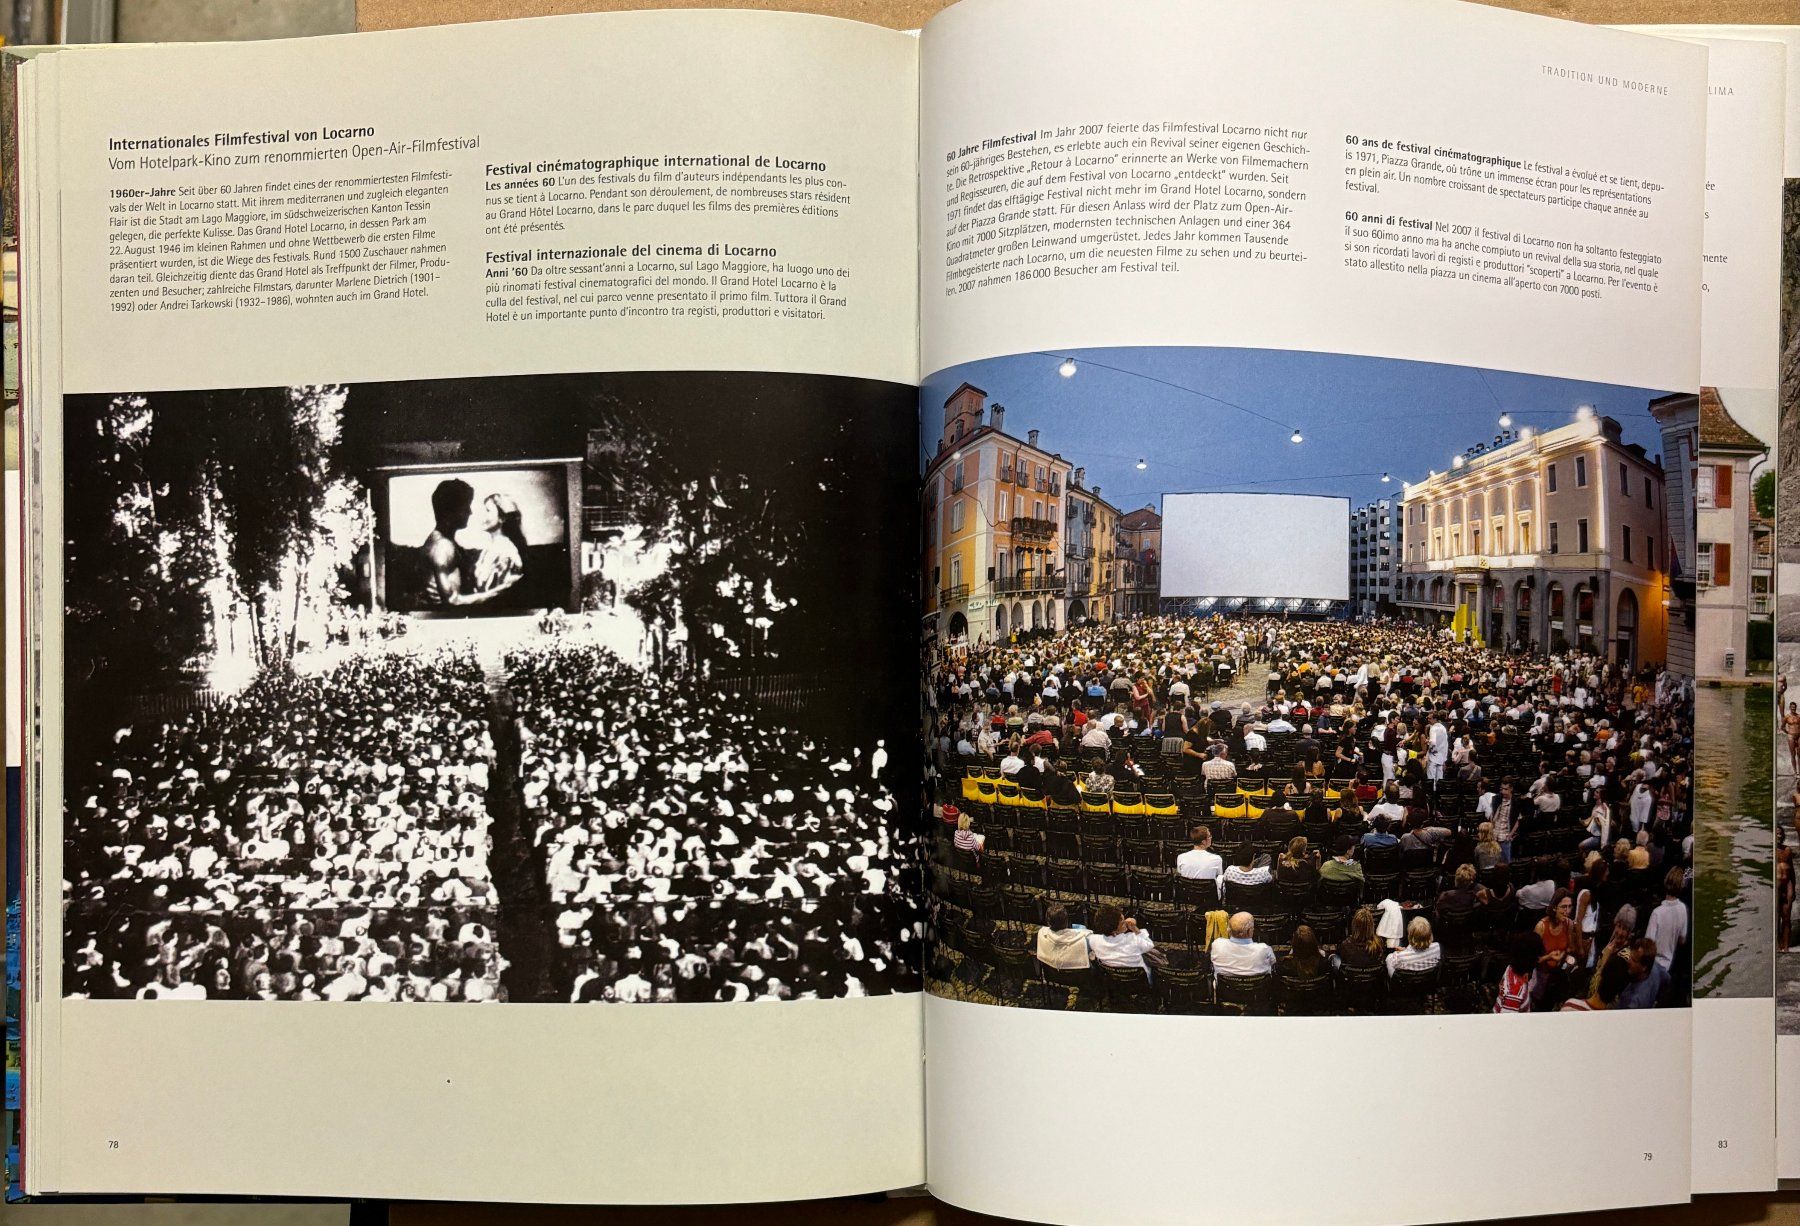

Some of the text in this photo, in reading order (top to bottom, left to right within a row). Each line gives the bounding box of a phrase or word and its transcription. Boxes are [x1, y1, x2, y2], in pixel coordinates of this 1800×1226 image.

[1542, 65, 1668, 96] TRADITION UND MODERNE
[109, 126, 375, 150] Internationales Filmfestival von Locarno
[946, 121, 1307, 162] 60 Jahre Filmfestival Im Jahr 2007 feierte das Filmfestival Locarno nicht nur
[108, 135, 480, 171] Vom Hotelpark-Kino zum renommierten Open-Air-Filmfestival
[485, 154, 826, 176] Festival cinématographique international de Locarno
[1345, 134, 1359, 145] 60
[1361, 138, 1379, 148] ans
[1381, 139, 1394, 150] de
[1396, 140, 1431, 154] festival
[1433, 148, 1522, 169] cinématographique
[1523, 160, 1533, 170] Le
[1534, 161, 1563, 175] festival
[1571, 168, 1598, 181] évolué
[1599, 174, 1608, 183] et
[1609, 176, 1618, 184] se
[1619, 176, 1640, 189] tient,
[1641, 180, 1664, 192] depu-
[109, 169, 452, 198] 1960er-Jahre Seit über 60 Jahren findet eines der renommiertesten Filmfesti-
[485, 186, 850, 205] nus se tient à Locarno. Pendant son déroulement, de nombreuses stars résident
[946, 193, 959, 207] und
[960, 184, 1009, 203] Regisseuren,
[1010, 180, 1025, 190] die
[1026, 175, 1043, 187] auf
[1045, 174, 1067, 184] dem
[1069, 170, 1106, 182] Festival
[1108, 171, 1128, 179] von
[1131, 168, 1171, 178] Locarno
[1228, 171, 1268, 182] wurden.
[1270, 172, 1288, 184] Seit
[1345, 179, 1379, 193] festival.
[109, 200, 430, 226] Flair ist die Stadt am Lago Maggiore, im südschweizerischen Kanton Tessin
[485, 220, 565, 234] ont été présentés.
[1345, 210, 1662, 264] 60 anni di festival Nel 2007 il festival di Locarno non ha soltanto festeggiato
[109, 243, 446, 271] präsentiert wurden, ist die Wiege des Festivals. Rund 1500 Zuschauer nahmen
[485, 243, 777, 264] Festival internazionale del cinema di Locarno
[945, 230, 1288, 266] Quadratmeter großen Leinwand umgerüstet. Jedes Jahr kommen Tausende
[485, 275, 836, 295] più rinomati festival cinematografici del mondo. Il Grand Hotel Locarno è la
[111, 300, 135, 312] 1992)
[137, 301, 158, 311] oder
[159, 299, 189, 310] Andrei
[190, 298, 233, 309] Tarkowski
[295, 294, 334, 304] wohnten
[335, 291, 358, 302] auch
[359, 290, 371, 300] im
[373, 288, 401, 299] Grand
[402, 286, 428, 297] Hotel.
[1718, 1140, 1727, 1148] 83
